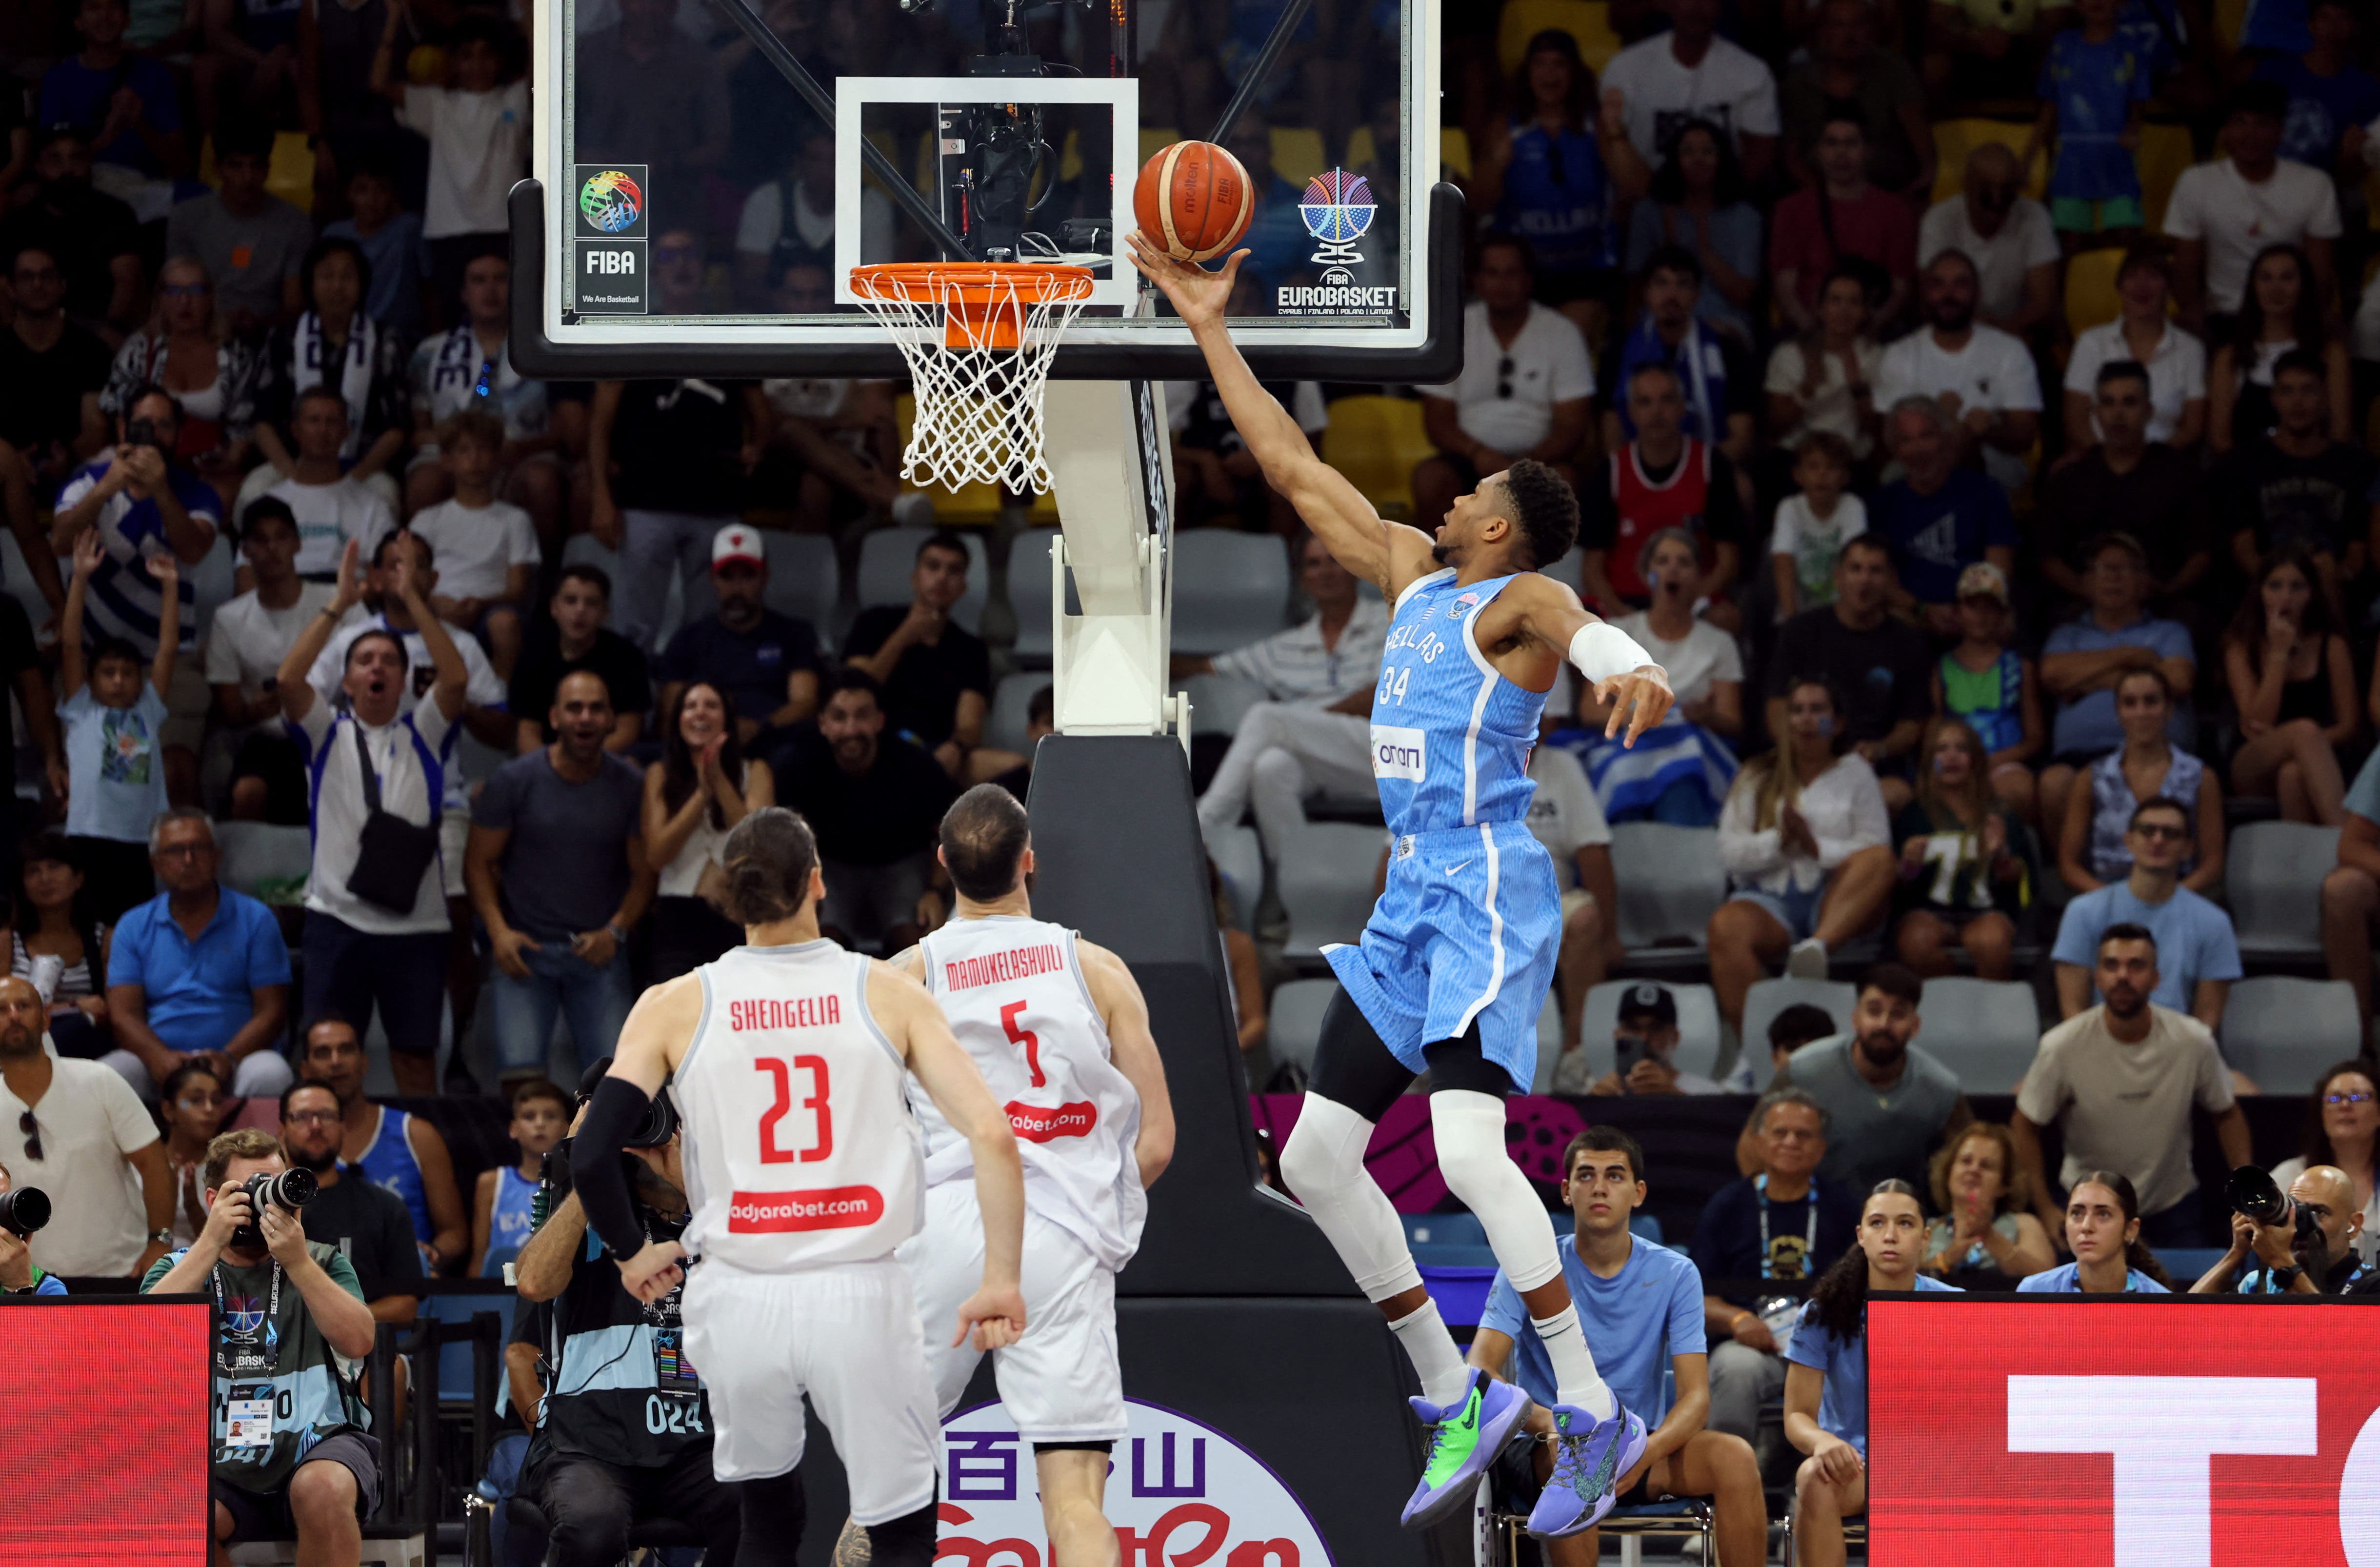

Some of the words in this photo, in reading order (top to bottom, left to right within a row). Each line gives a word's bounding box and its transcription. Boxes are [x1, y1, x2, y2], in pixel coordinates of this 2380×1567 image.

[1184, 162, 1199, 213] molten
[1218, 178, 1229, 204] FIBA
[587, 251, 635, 274] FIBA
[1326, 274, 1348, 284] FIBA
[1278, 286, 1397, 306] EUROBASKET
[1384, 623, 1445, 664] HELLAS
[1379, 665, 1411, 706] 34
[946, 944, 1063, 991] MAMUKELASHVILI
[731, 994, 840, 1031] SHENGELIA
[1000, 1000, 1046, 1087] 5
[755, 1054, 833, 1164] 23
[730, 1198, 868, 1224] adjarabet.com
[646, 1394, 705, 1435] 024
[945, 1432, 1206, 1500] 百山
[2007, 1374, 2380, 1567] T
